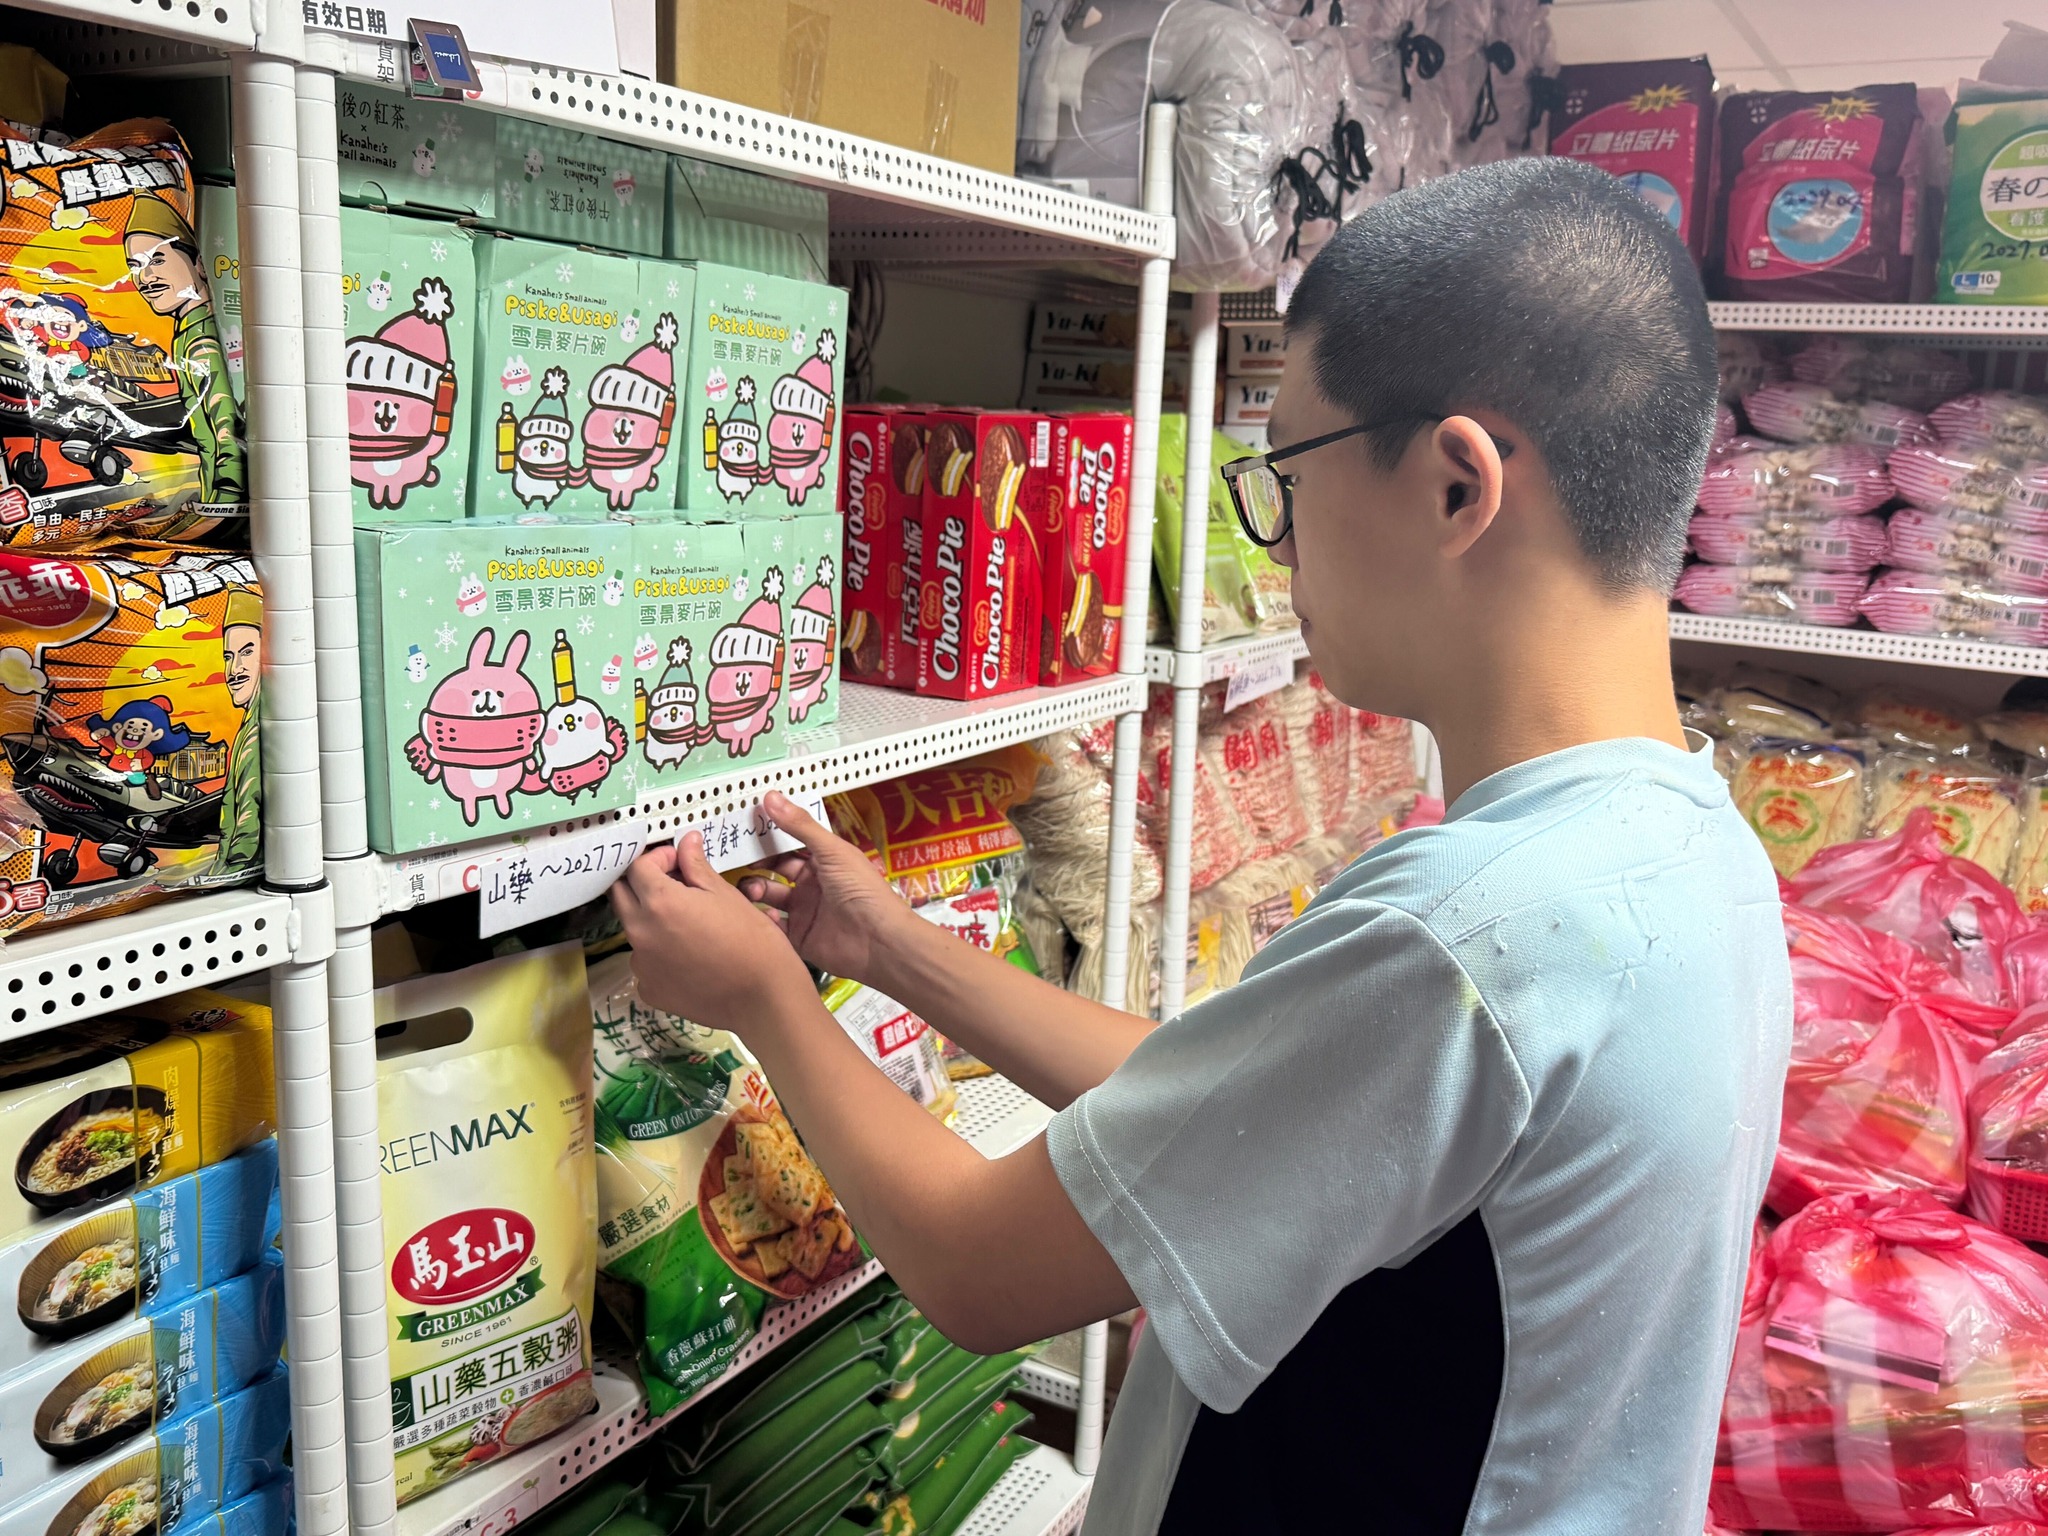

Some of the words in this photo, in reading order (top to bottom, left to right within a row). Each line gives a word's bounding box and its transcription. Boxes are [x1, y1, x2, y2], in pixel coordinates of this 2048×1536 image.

[303, 1, 387, 34] 有效日期
[341, 92, 405, 129] 後の紅茶
[340, 130, 388, 153] Kanahei's
[338, 148, 357, 161] mall
[360, 150, 397, 168] animals
[525, 283, 563, 299] Kanahei's
[565, 292, 583, 303] Small
[505, 294, 618, 330] Piske&Usagi
[709, 313, 790, 343] Piske&Usagi
[511, 324, 607, 356] 雪景麥片碗
[1080, 445, 1098, 504] Pie
[199, 505, 234, 514] Jerome
[1093, 442, 1115, 549] Choco
[505, 545, 539, 556] Kanahei's
[541, 546, 561, 554] Small
[562, 546, 590, 554] animals
[488, 556, 604, 582] Piske&Usagi
[495, 584, 597, 613] 雪景麥片碗
[634, 574, 730, 598] Piske&Usagi
[12, 606, 45, 614] SINCE
[46, 602, 72, 612] 1968
[640, 600, 722, 626] 雪景麥片碗
[919, 638, 928, 676] LOTTE
[204, 875, 238, 883] Jerome
[380, 1104, 534, 1174] REENMAX
[629, 1118, 669, 1139] GREEN
[159, 1185, 177, 1252] 海鮮味
[598, 1193, 671, 1250] 嚴選食材
[408, 1217, 525, 1290] 馬玉山
[145, 1245, 160, 1304] ラーメン
[416, 1283, 530, 1338] GREENMAX
[179, 1307, 196, 1371] 海鮮味
[441, 1328, 482, 1348] SINCE
[485, 1316, 513, 1332] 1961
[421, 1316, 579, 1415] 山藥五穀粥
[691, 1353, 717, 1372] Onion
[162, 1364, 178, 1420] ラーメン
[183, 1421, 199, 1485] 海鮮味
